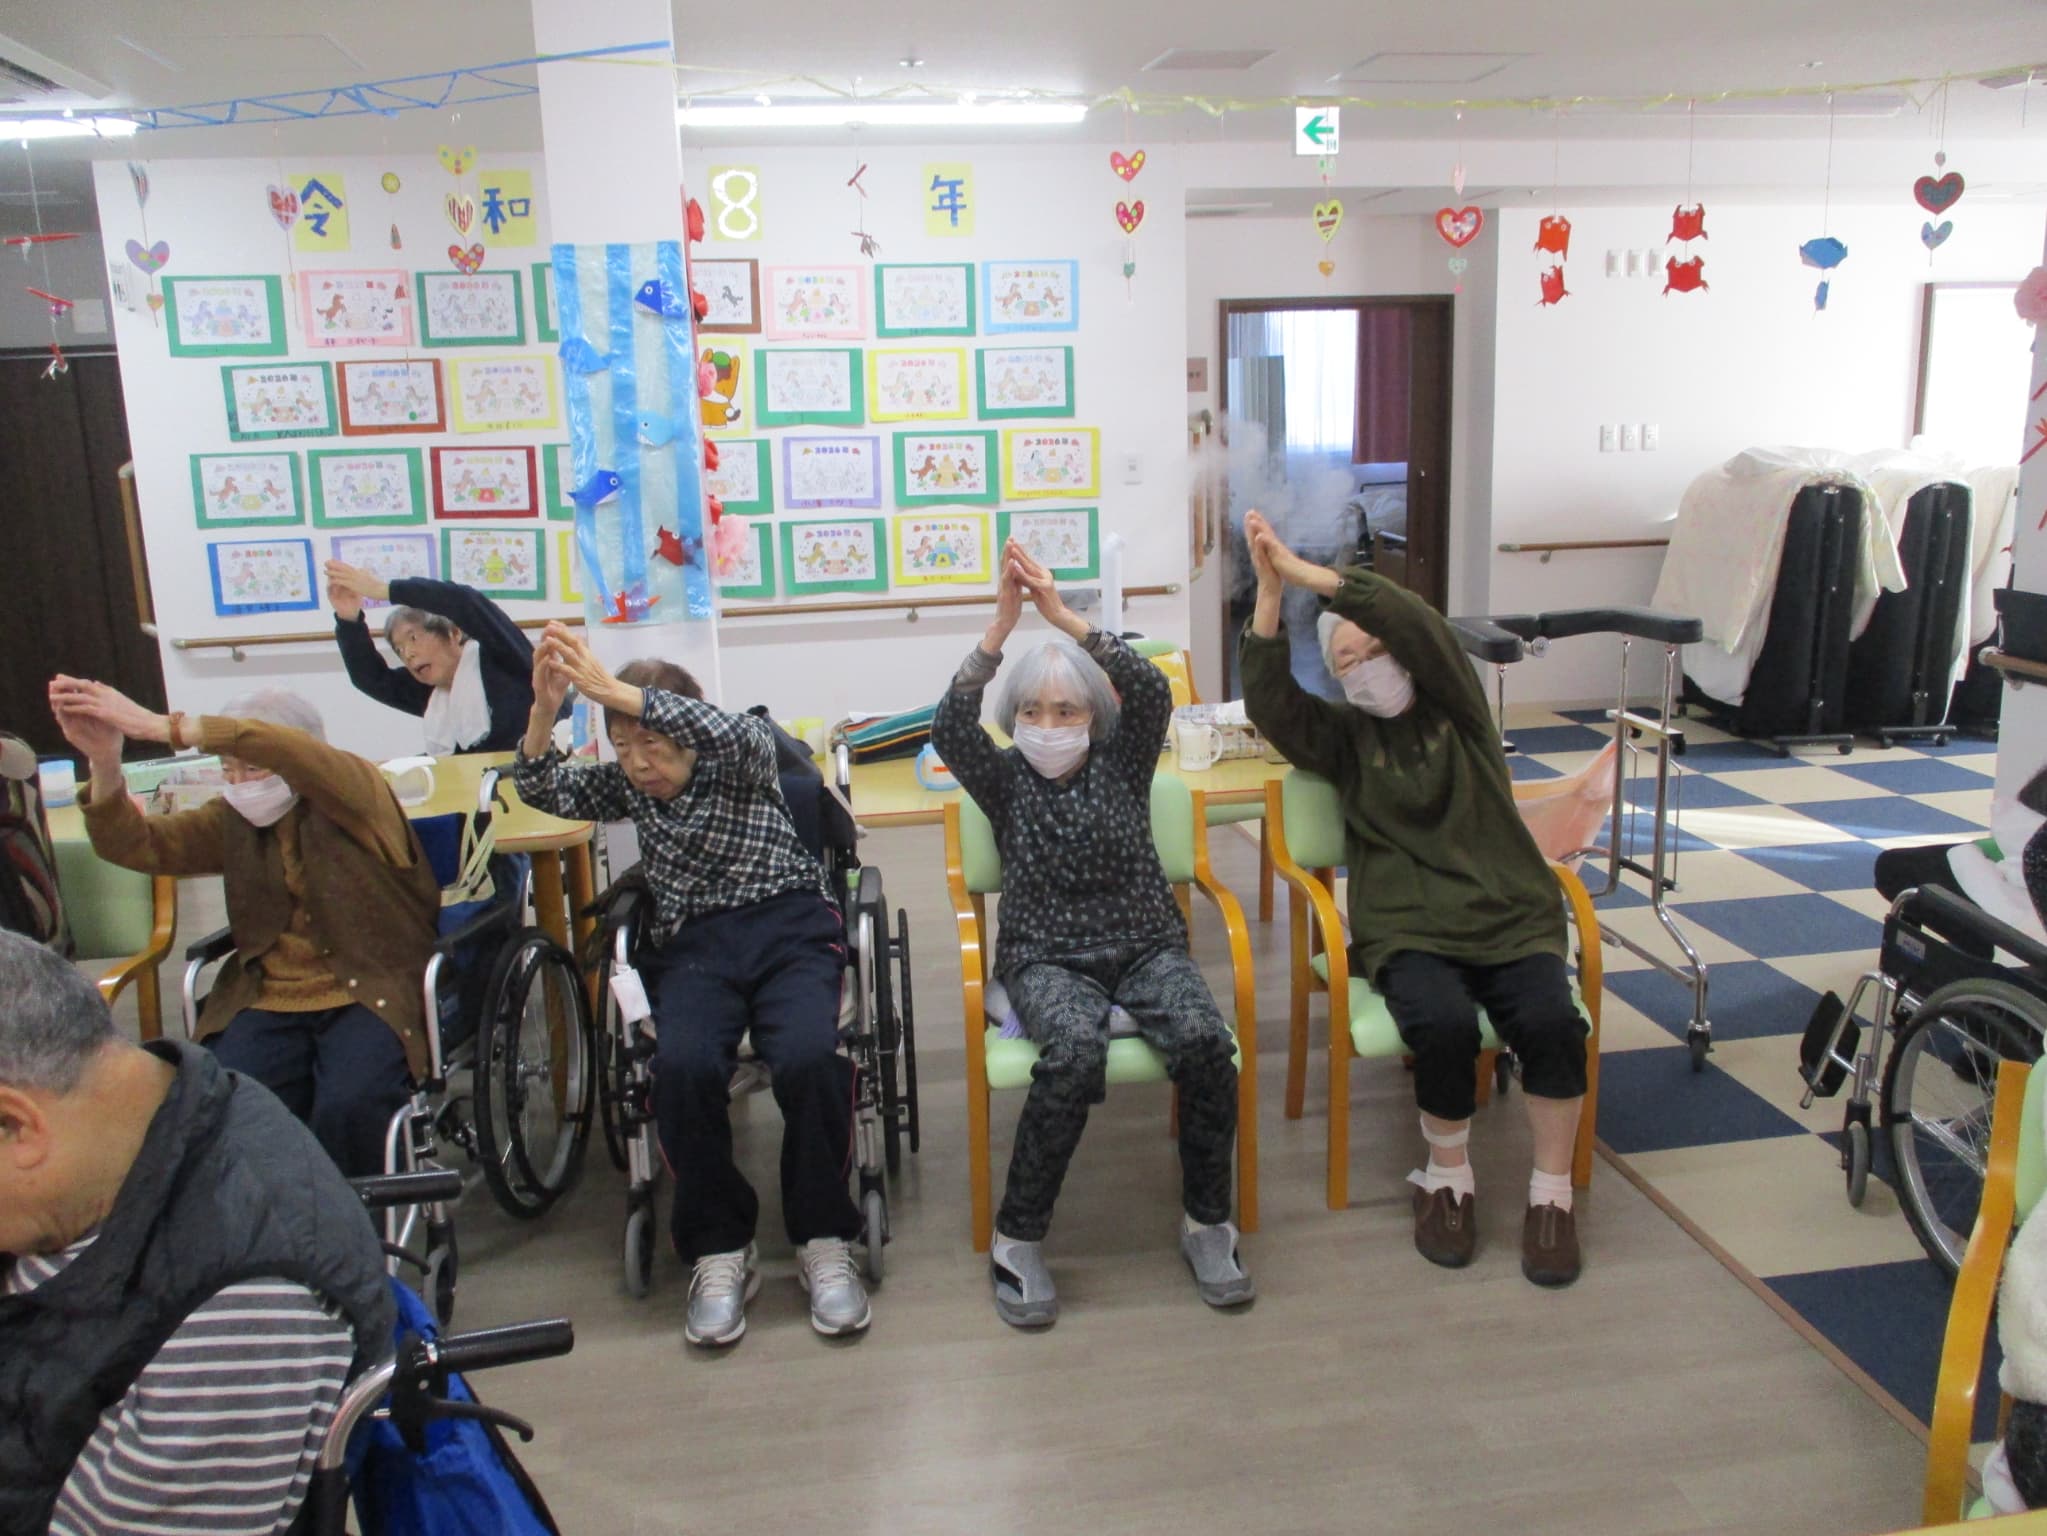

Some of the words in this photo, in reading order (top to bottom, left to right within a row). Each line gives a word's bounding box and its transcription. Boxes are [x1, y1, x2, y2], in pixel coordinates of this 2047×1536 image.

[300, 177, 344, 237] 令
[482, 187, 531, 234] 和
[712, 169, 758, 239] 8
[930, 174, 967, 227] 年
